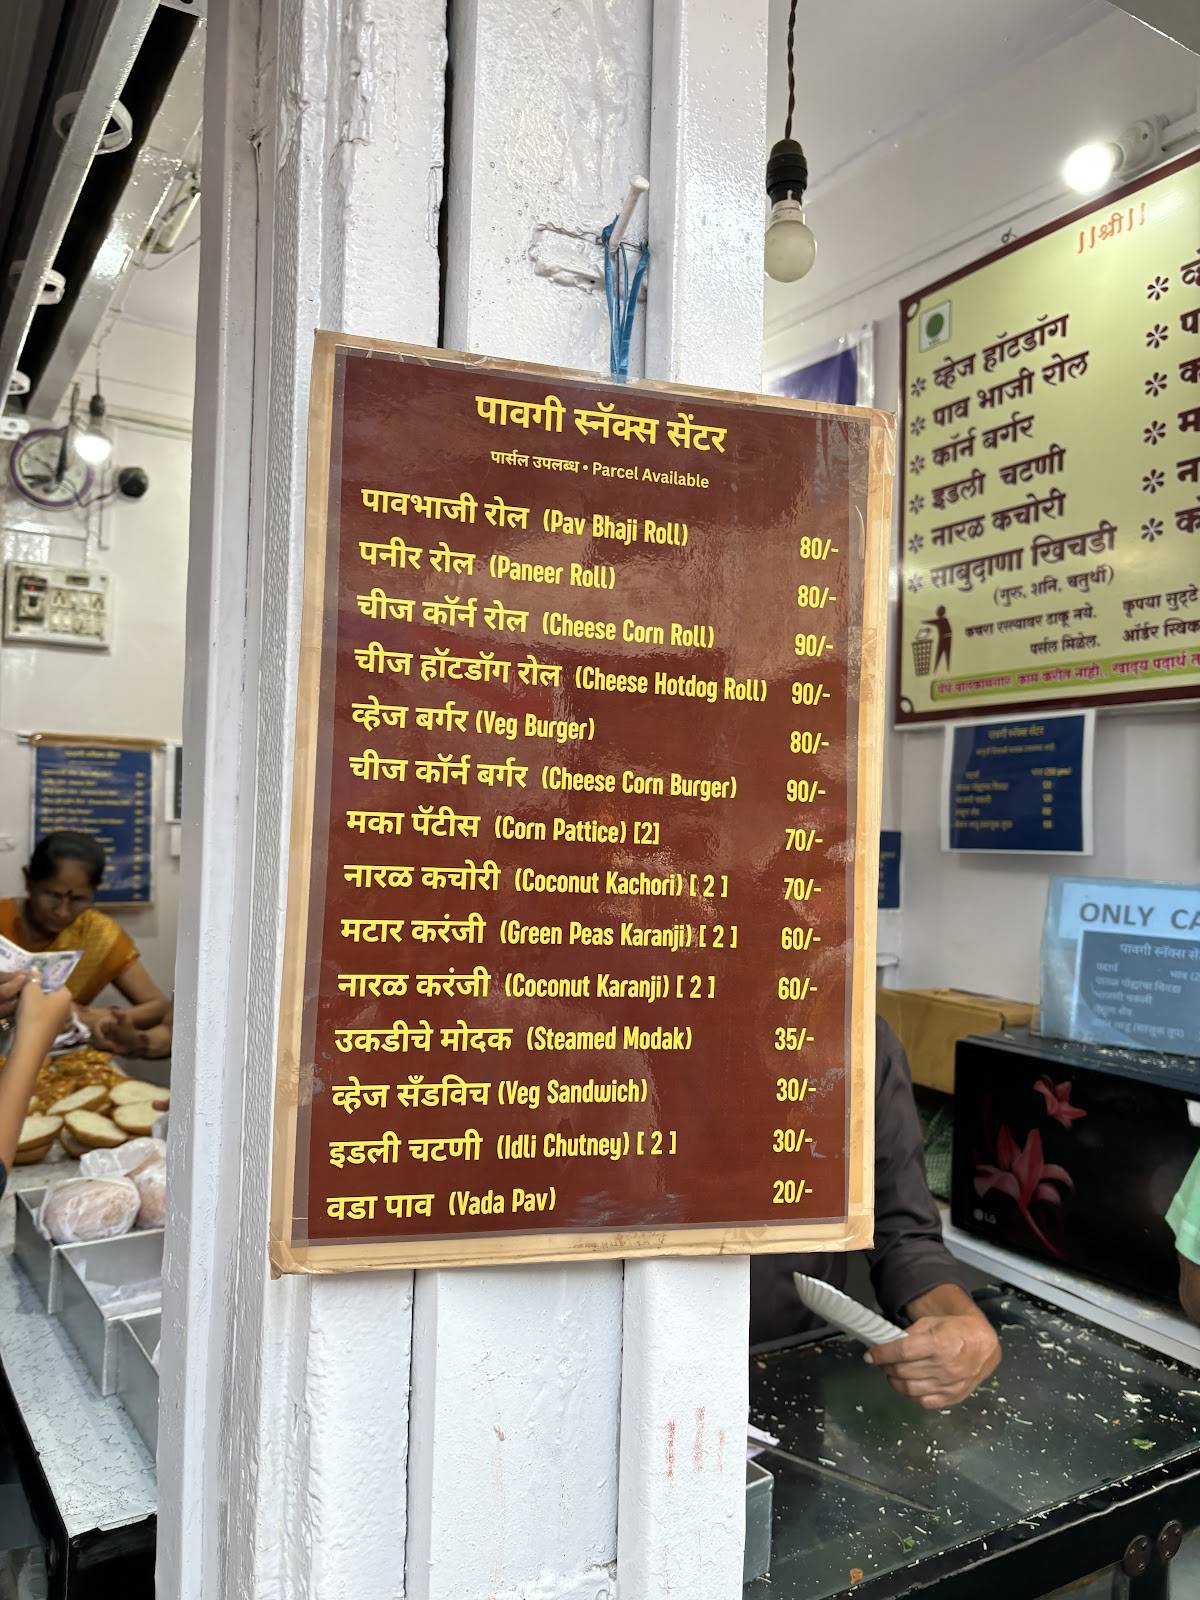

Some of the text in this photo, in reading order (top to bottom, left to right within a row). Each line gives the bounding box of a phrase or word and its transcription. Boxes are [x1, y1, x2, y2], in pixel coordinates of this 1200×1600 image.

[982, 314, 1069, 372] हॉटडॉग
[932, 350, 1089, 426] पाव भाजी रोल
[475, 394, 728, 454] पावगी स्नॅक्स सेंटर
[982, 411, 1035, 449] बर्गर
[490, 449, 710, 489] पार्सल उपलब्ध Parcel Available
[931, 444, 1066, 510] इडली चटणी
[360, 488, 839, 561] पावभाजी रोल (Pav Bhaji Roll) 80/-
[931, 488, 1066, 547] नारळ कचोरी
[1031, 520, 1117, 567] खिचडी
[358, 536, 837, 609] पनीर रोल (Paneer Roll) 80/-
[356, 587, 834, 658] चीज कॉर्न रोल (Cheese Corn Roll) 90/-
[353, 641, 831, 706] चीज हॉटडॉग रोल (Cheese Hotdog Roll) 90/-
[351, 694, 830, 755] व्हेज बर्गर (Veg Burger) 80/-
[348, 748, 826, 803] चीज कॉर्न बर्गर (Cheese Corn Burger) 90/-
[346, 804, 824, 852] मका पॅटीस (Corn Pattice) [2] 70/-
[343, 864, 415, 889] नारळ
[420, 858, 502, 891] कचोरी
[514, 867, 600, 894] (Coconut
[605, 870, 683, 897] Kachori)
[783, 877, 822, 901] 70/-
[340, 918, 405, 943] मटार
[410, 911, 487, 944] करंजी
[500, 919, 563, 945] (Green
[569, 921, 614, 946] Peas
[620, 922, 693, 953] Karanji)
[781, 926, 821, 951] 60/-
[1080, 902, 1200, 930] ONLY CA
[337, 974, 410, 998] नारळ
[415, 965, 492, 998] करंजी
[504, 972, 591, 998] (Coconut
[596, 973, 670, 1004] Karanji)
[778, 976, 818, 1001] 60/-
[334, 1019, 815, 1054] उकडीचे मोदक (Steamed Modak) 35/-
[331, 1075, 391, 1115] व्हेज
[497, 1080, 541, 1110] (Veg
[546, 1078, 648, 1105] Sandwich)
[776, 1077, 817, 1102] 30/-
[328, 1130, 402, 1169] इडली
[407, 1128, 484, 1162] चटणी
[496, 1134, 537, 1160] (Idli
[543, 1131, 630, 1161] Chutney)
[772, 1128, 813, 1153] 30/-
[326, 1179, 813, 1221] वडा पाव (Vada Pav) 20/-
[984, 1212, 997, 1225] LG
